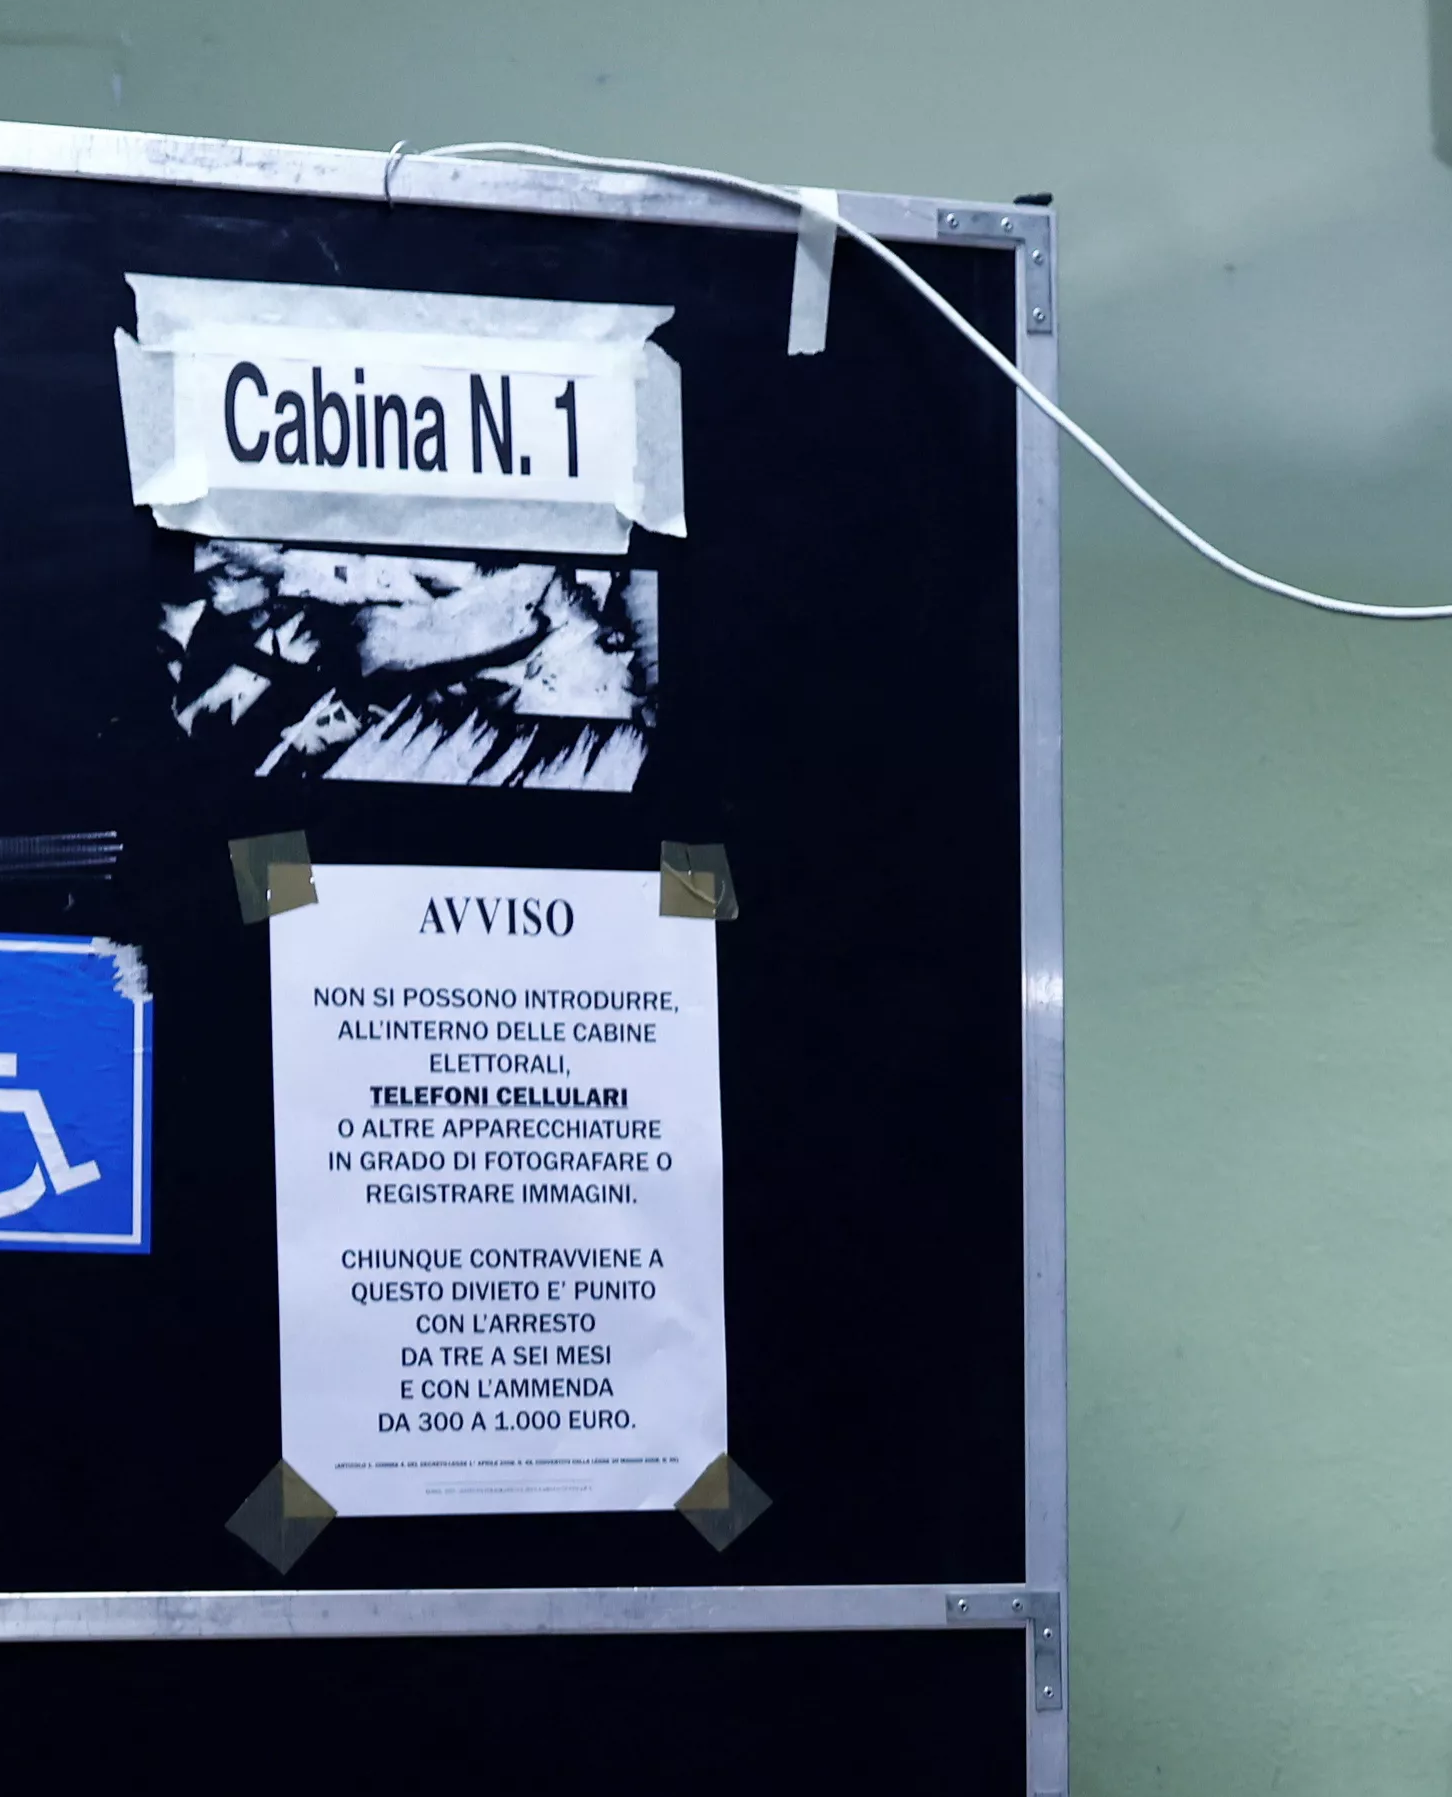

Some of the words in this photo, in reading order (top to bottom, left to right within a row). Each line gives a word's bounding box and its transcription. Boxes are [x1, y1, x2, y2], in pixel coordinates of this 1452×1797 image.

[224, 361, 448, 473] Cabina
[469, 373, 531, 476] N.
[554, 379, 579, 478] 1
[418, 896, 575, 938] AVVISO
[313, 986, 365, 1008] NON
[372, 986, 395, 1009] SI
[403, 987, 518, 1009] POSSONO
[524, 988, 679, 1014] INTRODURRE,
[337, 1019, 489, 1042] ALL'INTERNO
[496, 1020, 566, 1043] DELLE
[572, 1021, 657, 1044] CABINE
[429, 1052, 571, 1079] ELETTORALI,
[369, 1085, 490, 1109] TELEFONI
[495, 1085, 629, 1109] CELLULARI
[337, 1117, 355, 1139] O
[361, 1117, 436, 1140] ALTRE
[441, 1117, 662, 1141] APPARECCHIATURE
[328, 1150, 352, 1172] IN
[359, 1150, 446, 1172] GRADO
[453, 1150, 476, 1172] DI
[484, 1150, 650, 1173] FOTOGRAFARE
[656, 1151, 673, 1172] O
[365, 1182, 515, 1205] REGISTRARE
[522, 1182, 638, 1205] IMMAGINI.
[341, 1248, 463, 1273] CHIUNQUE
[469, 1247, 643, 1270] CONTRAVVIENE
[648, 1247, 665, 1269] A
[350, 1280, 444, 1307] QUESTO
[451, 1280, 540, 1303] DIVIETO
[547, 1280, 566, 1302] E'
[574, 1279, 656, 1301] PUNITO
[415, 1313, 465, 1335] CON
[472, 1312, 596, 1335] L'ARRESTO
[401, 1346, 434, 1368] DA
[439, 1345, 484, 1368] TRE
[490, 1345, 507, 1367] A
[512, 1344, 548, 1367] SEI
[556, 1344, 612, 1367] MESI
[400, 1379, 415, 1401] E
[420, 1378, 470, 1401] CON
[477, 1376, 615, 1400] L'AMMENDA
[378, 1412, 411, 1433] DA
[418, 1410, 465, 1433] 300
[470, 1410, 487, 1432] A
[494, 1409, 562, 1432] 1.000
[568, 1408, 636, 1431] EURO.
